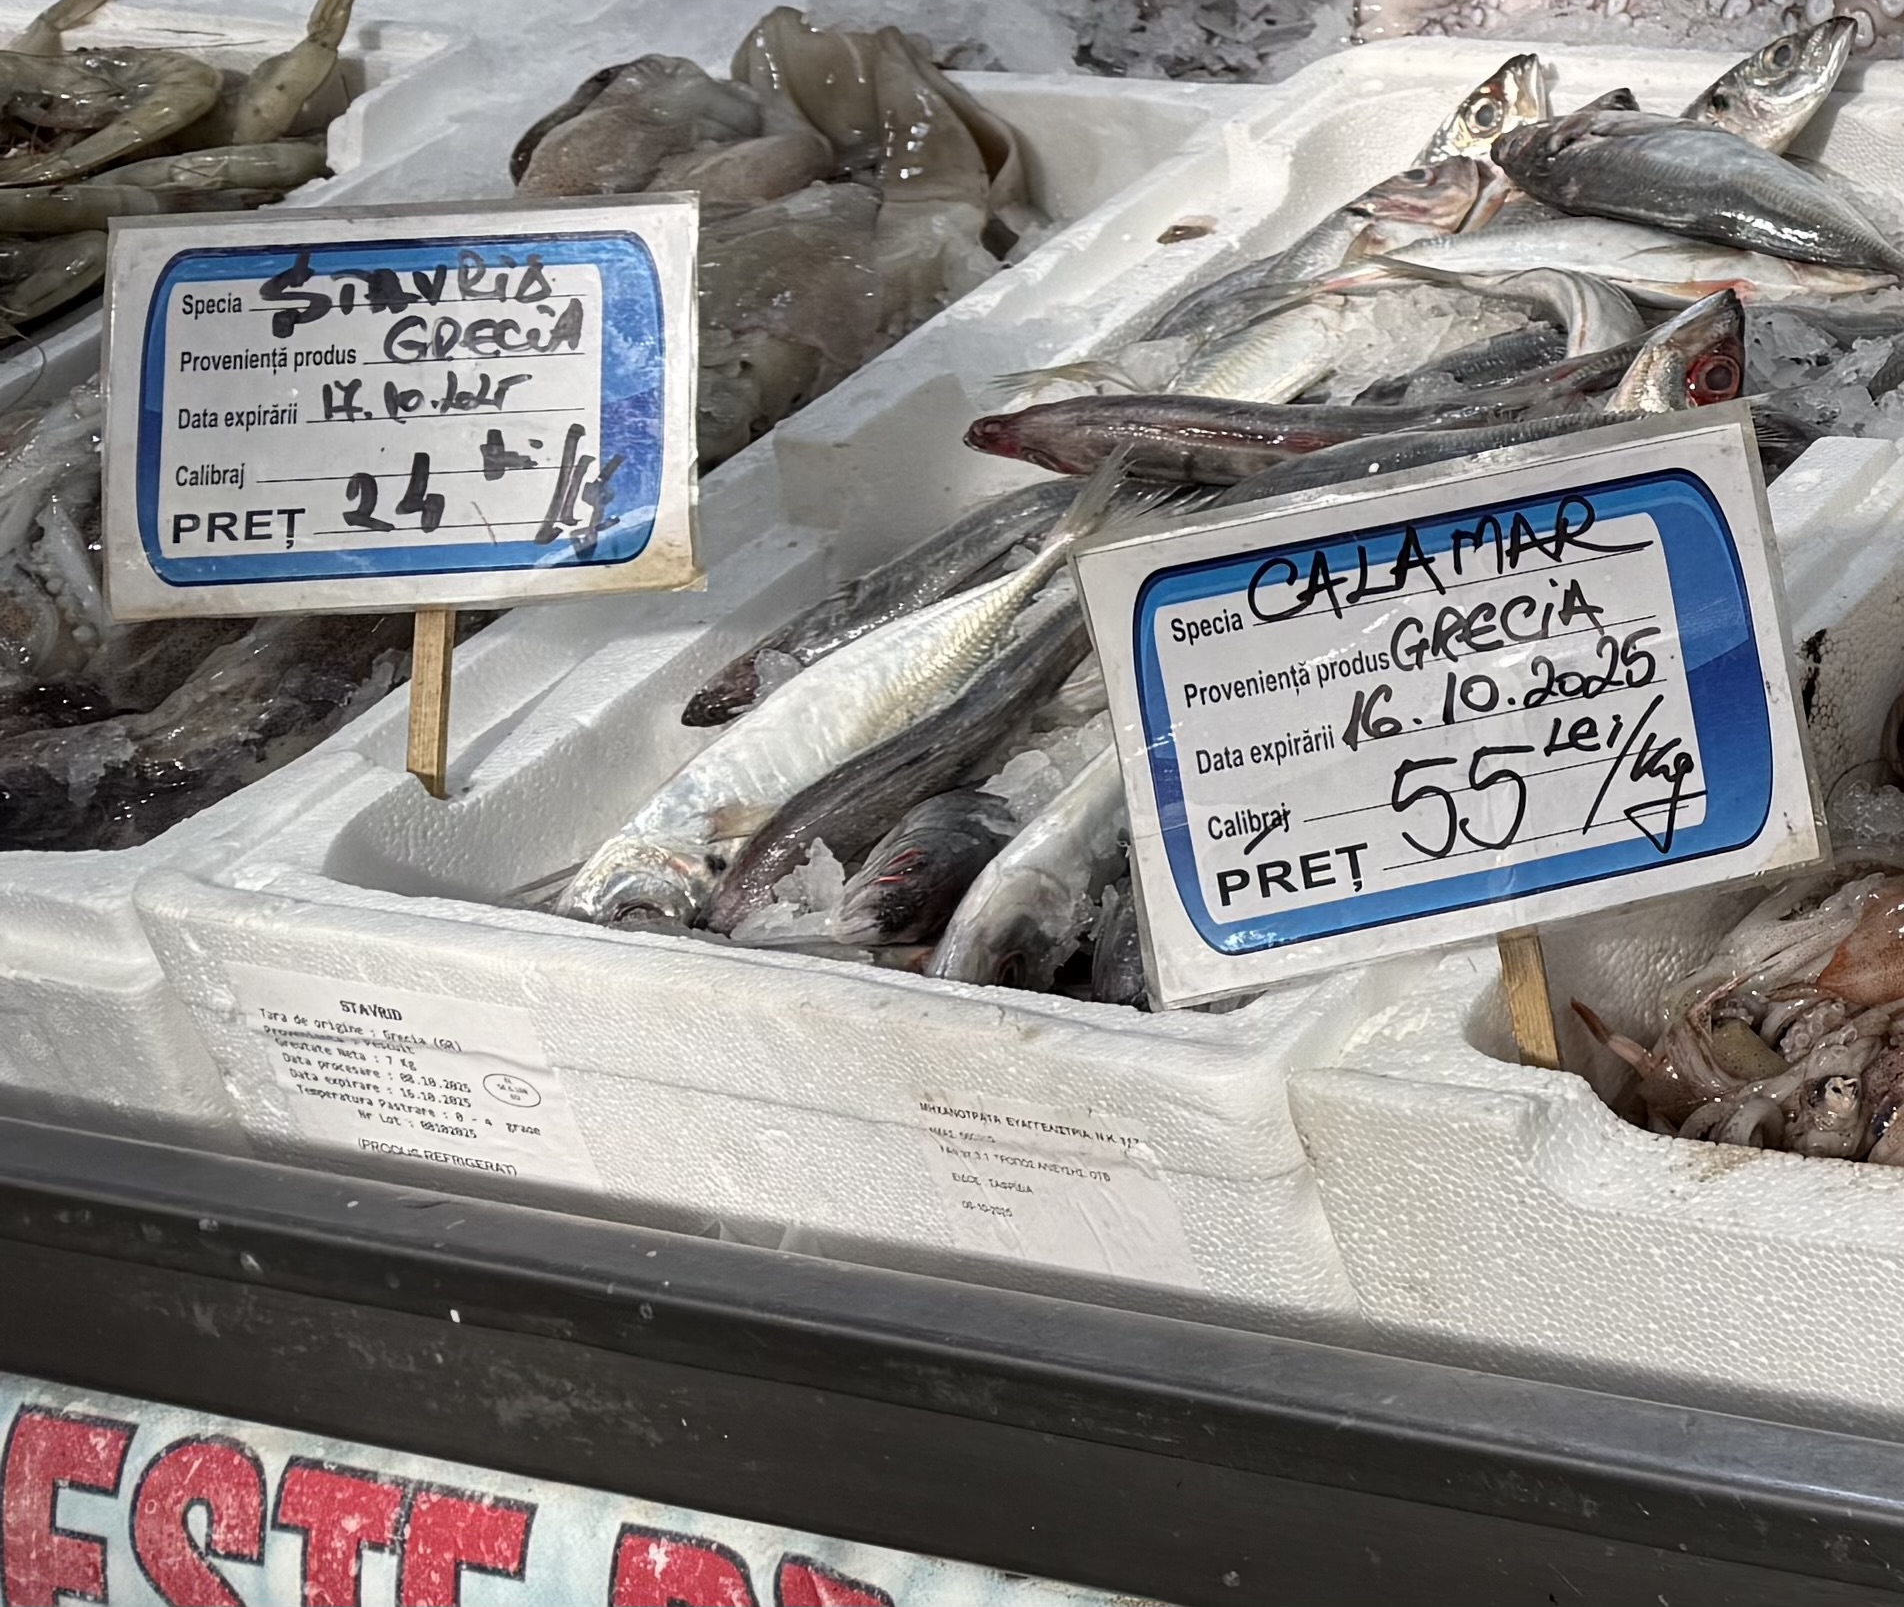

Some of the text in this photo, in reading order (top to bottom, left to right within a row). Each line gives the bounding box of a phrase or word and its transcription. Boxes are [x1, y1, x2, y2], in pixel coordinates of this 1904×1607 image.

[182, 294, 243, 319] Specia
[180, 347, 288, 376] Proveniență
[293, 345, 357, 372] produs
[178, 403, 298, 432] Data expirării
[175, 464, 246, 490] Calibraj
[172, 507, 306, 550] PREȚ
[1171, 609, 1244, 645] Specia
[1184, 662, 1310, 710] Proveniență
[1316, 648, 1390, 686] produs
[1195, 745, 1245, 778] Data
[1248, 725, 1336, 768] expirării
[1207, 807, 1292, 846] Calibraj
[1217, 745, 1535, 908] PREȚ 55
[339, 1000, 403, 1021] STAVRID
